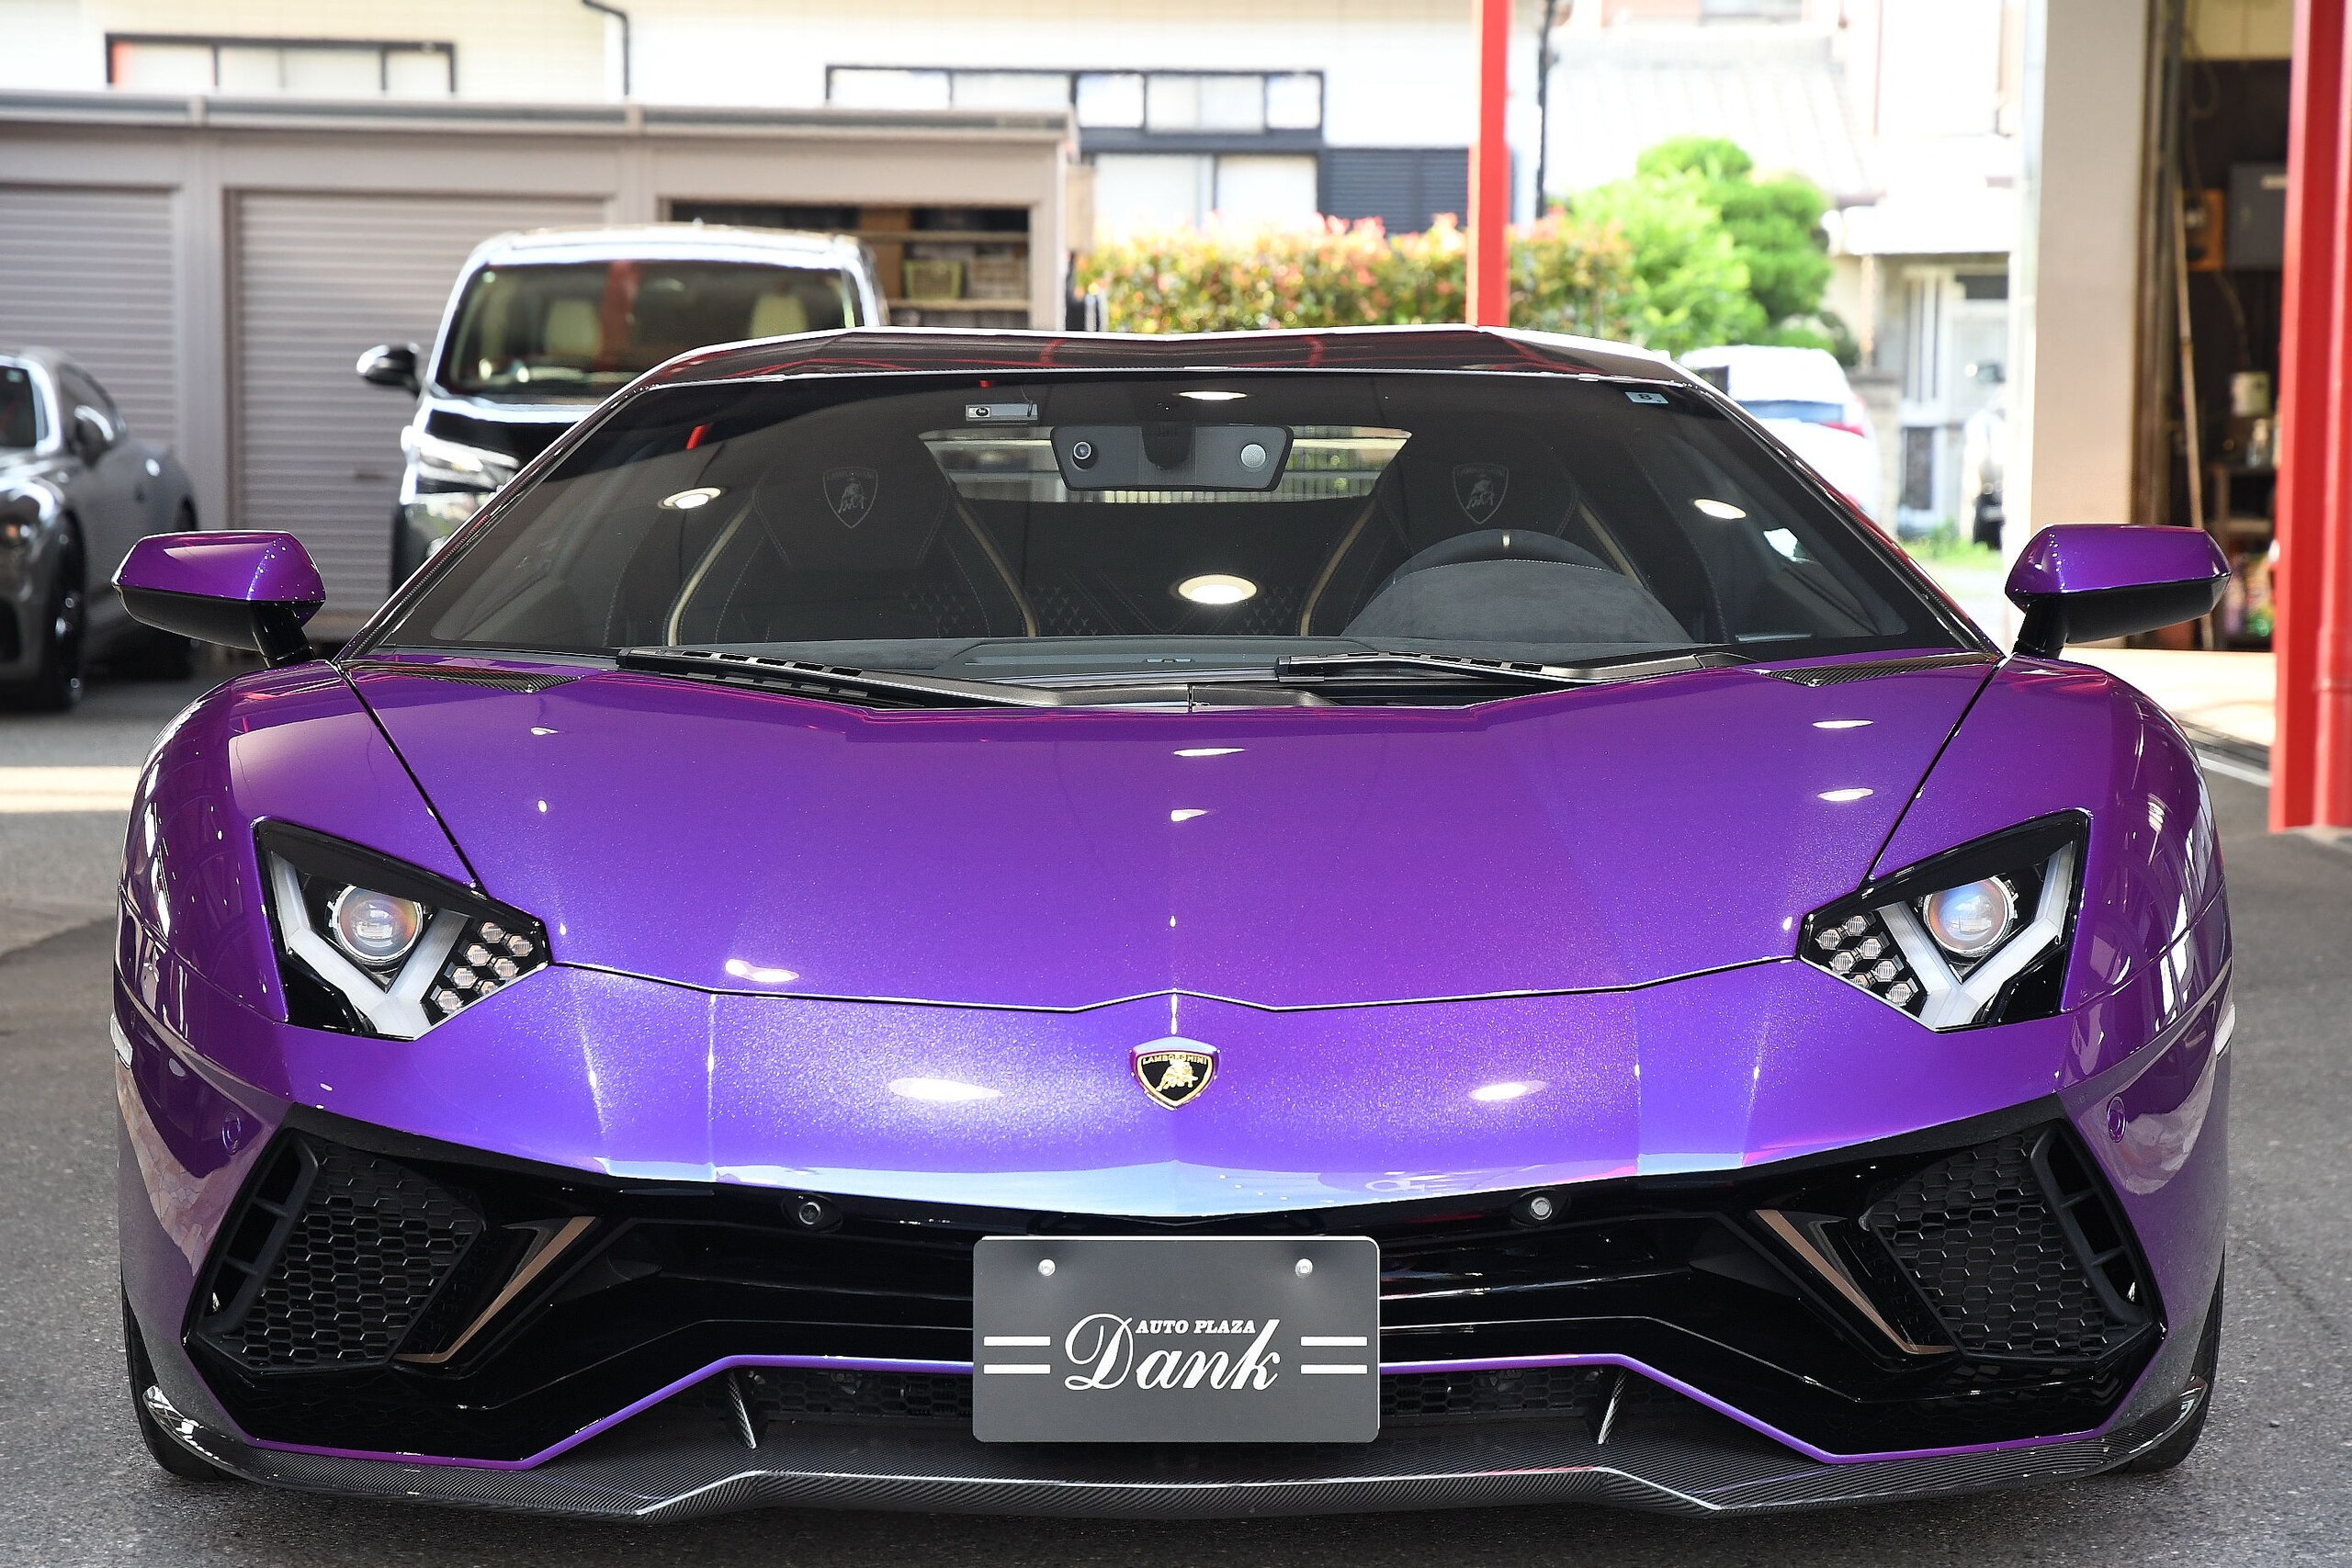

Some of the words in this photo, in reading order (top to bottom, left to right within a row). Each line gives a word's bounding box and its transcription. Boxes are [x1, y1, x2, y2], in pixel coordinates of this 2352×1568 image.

[1136, 1319, 1189, 1334] AUTO
[1193, 1319, 1256, 1334] PLAZA
[1065, 1314, 1281, 1390] Dank
